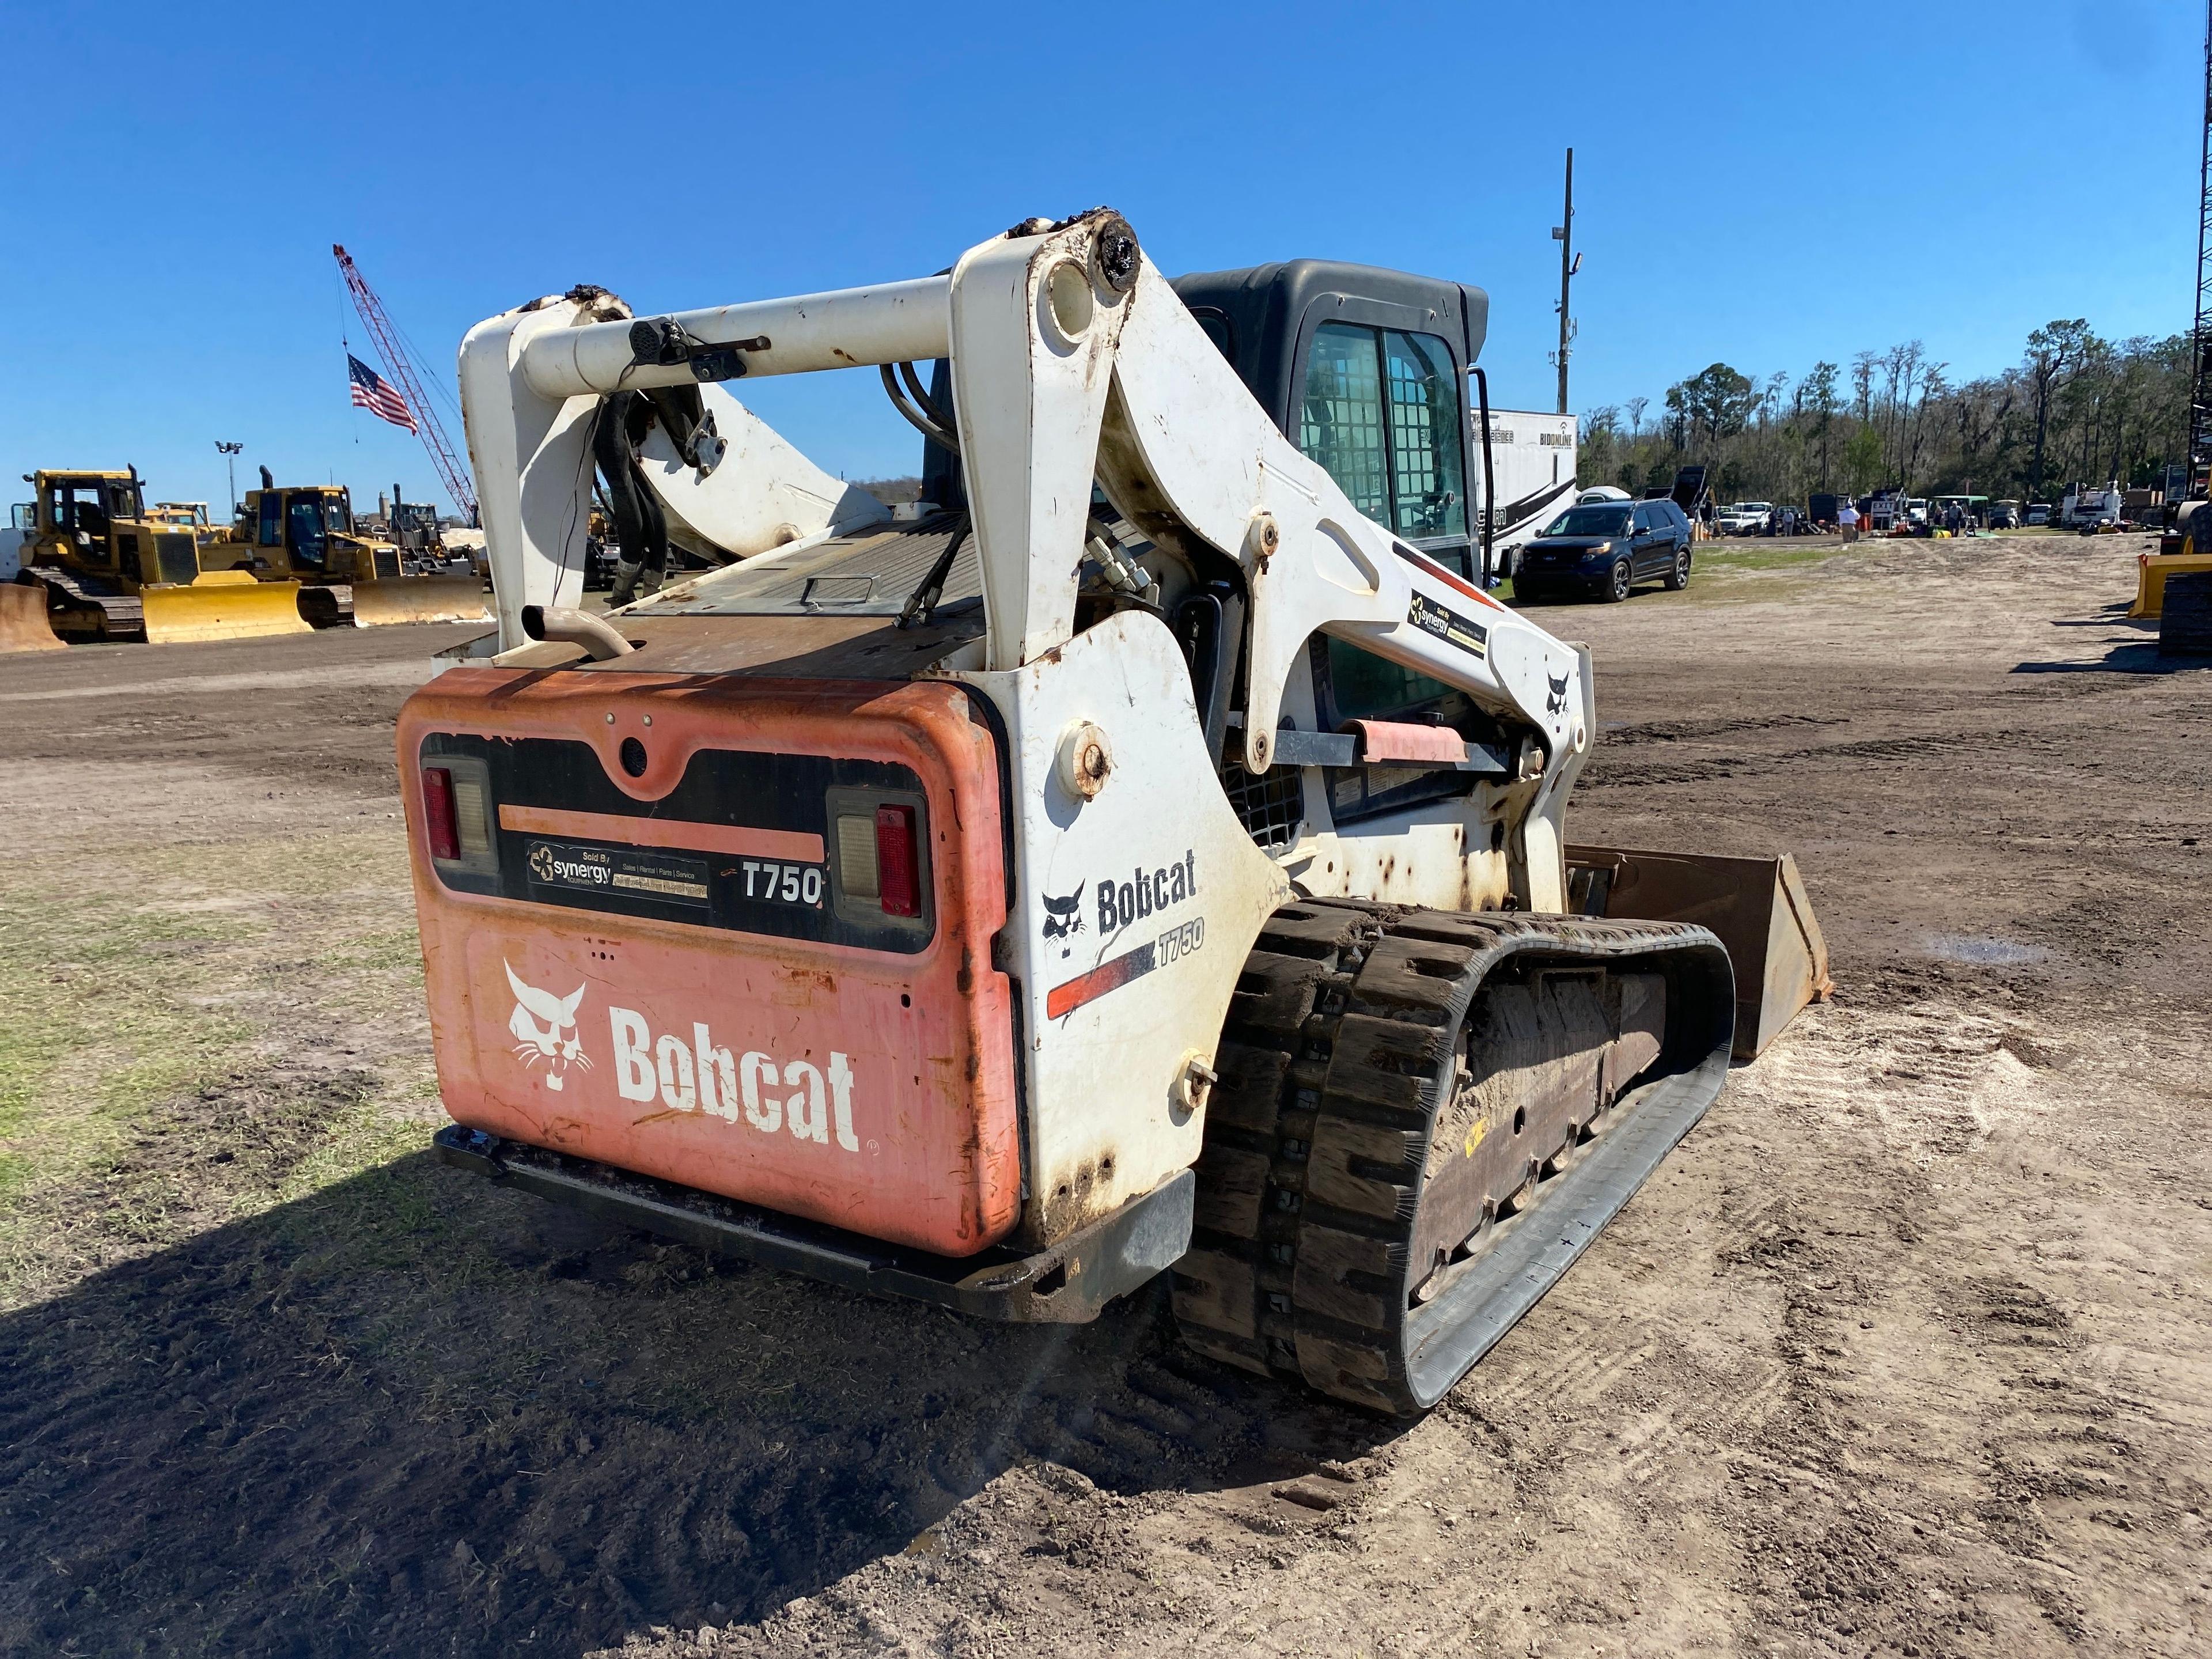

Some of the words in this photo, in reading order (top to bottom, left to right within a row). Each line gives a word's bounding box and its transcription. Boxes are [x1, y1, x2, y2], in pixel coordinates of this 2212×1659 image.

[1422, 609, 1448, 634] synergy
[554, 859, 611, 884] synergy
[582, 851, 599, 862] Sold
[743, 861, 822, 904] T750
[1097, 849, 1196, 937] Bobcat
[1159, 916, 1205, 967] T750
[609, 1005, 859, 1152] Bobcat
